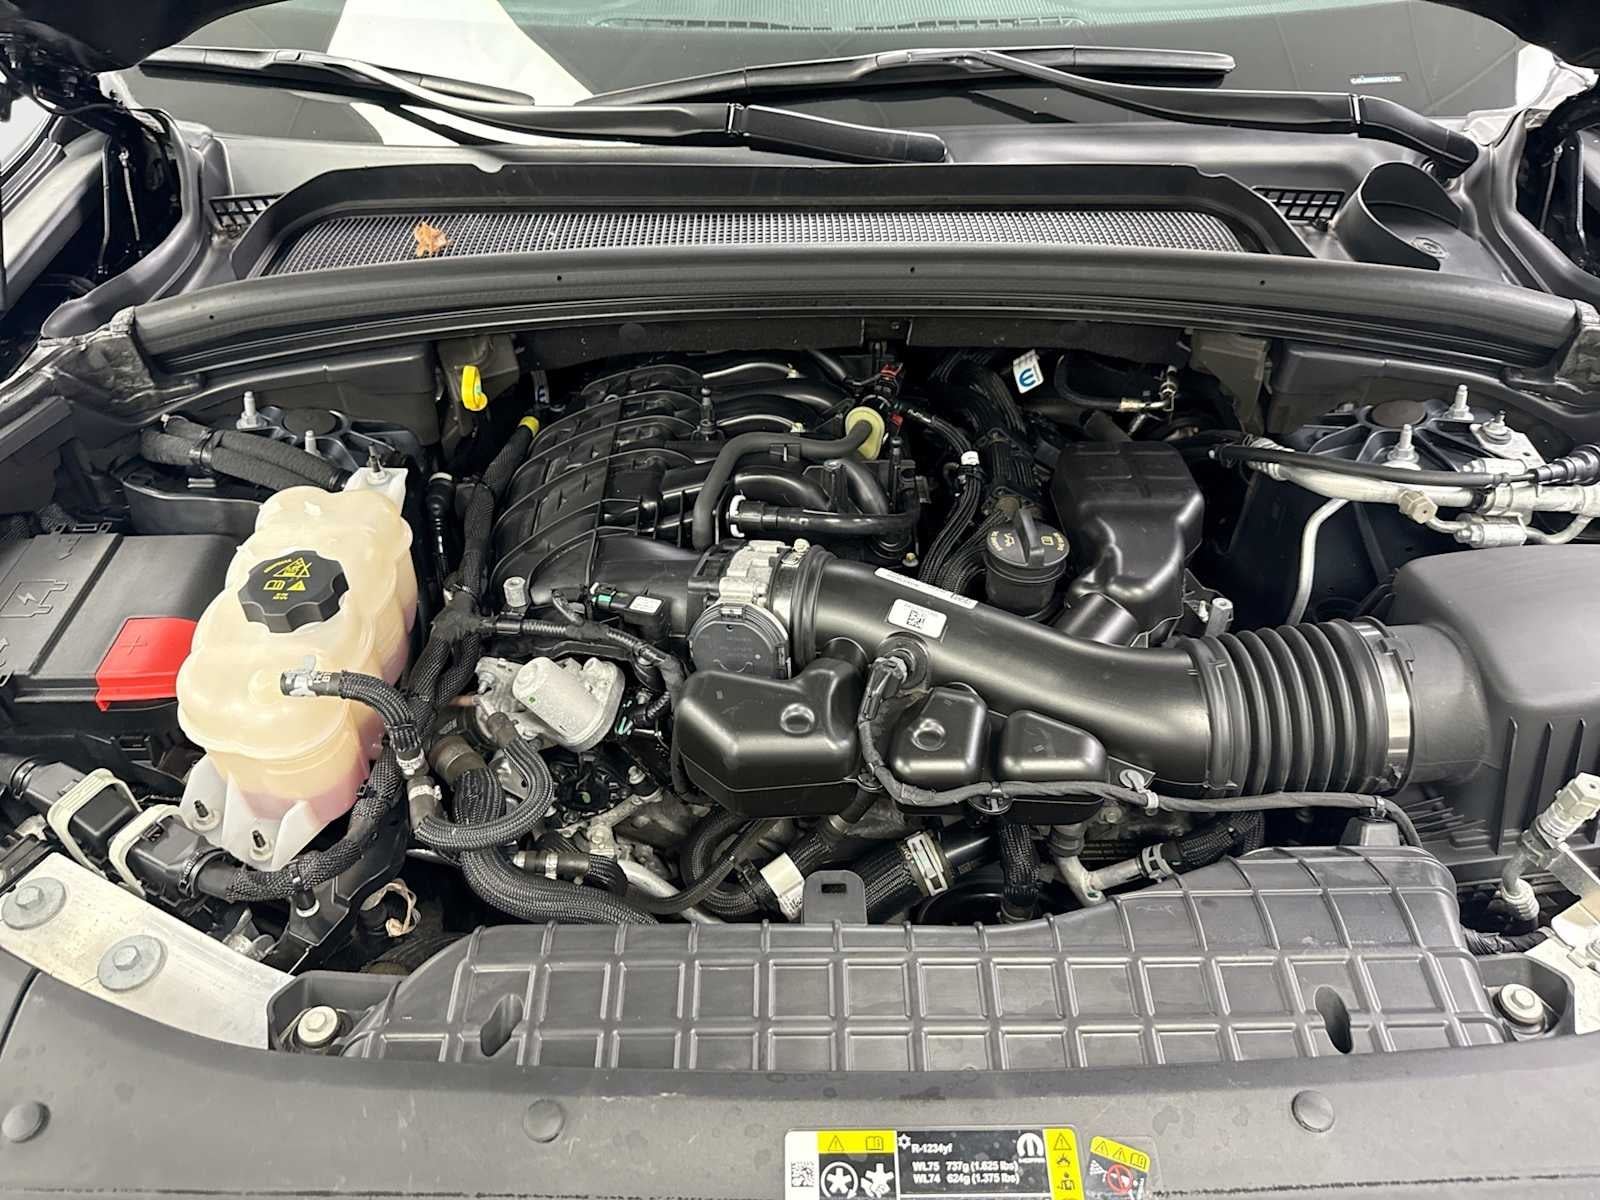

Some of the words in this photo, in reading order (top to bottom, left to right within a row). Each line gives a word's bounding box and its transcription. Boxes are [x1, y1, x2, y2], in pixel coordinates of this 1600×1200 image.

[912, 1161, 940, 1172] WL75
[945, 1161, 969, 1173] 737g
[1000, 1160, 1019, 1172] lbs)
[913, 1173, 941, 1184] WL74
[946, 1173, 970, 1185] 624g
[1000, 1172, 1020, 1184] lbs)
